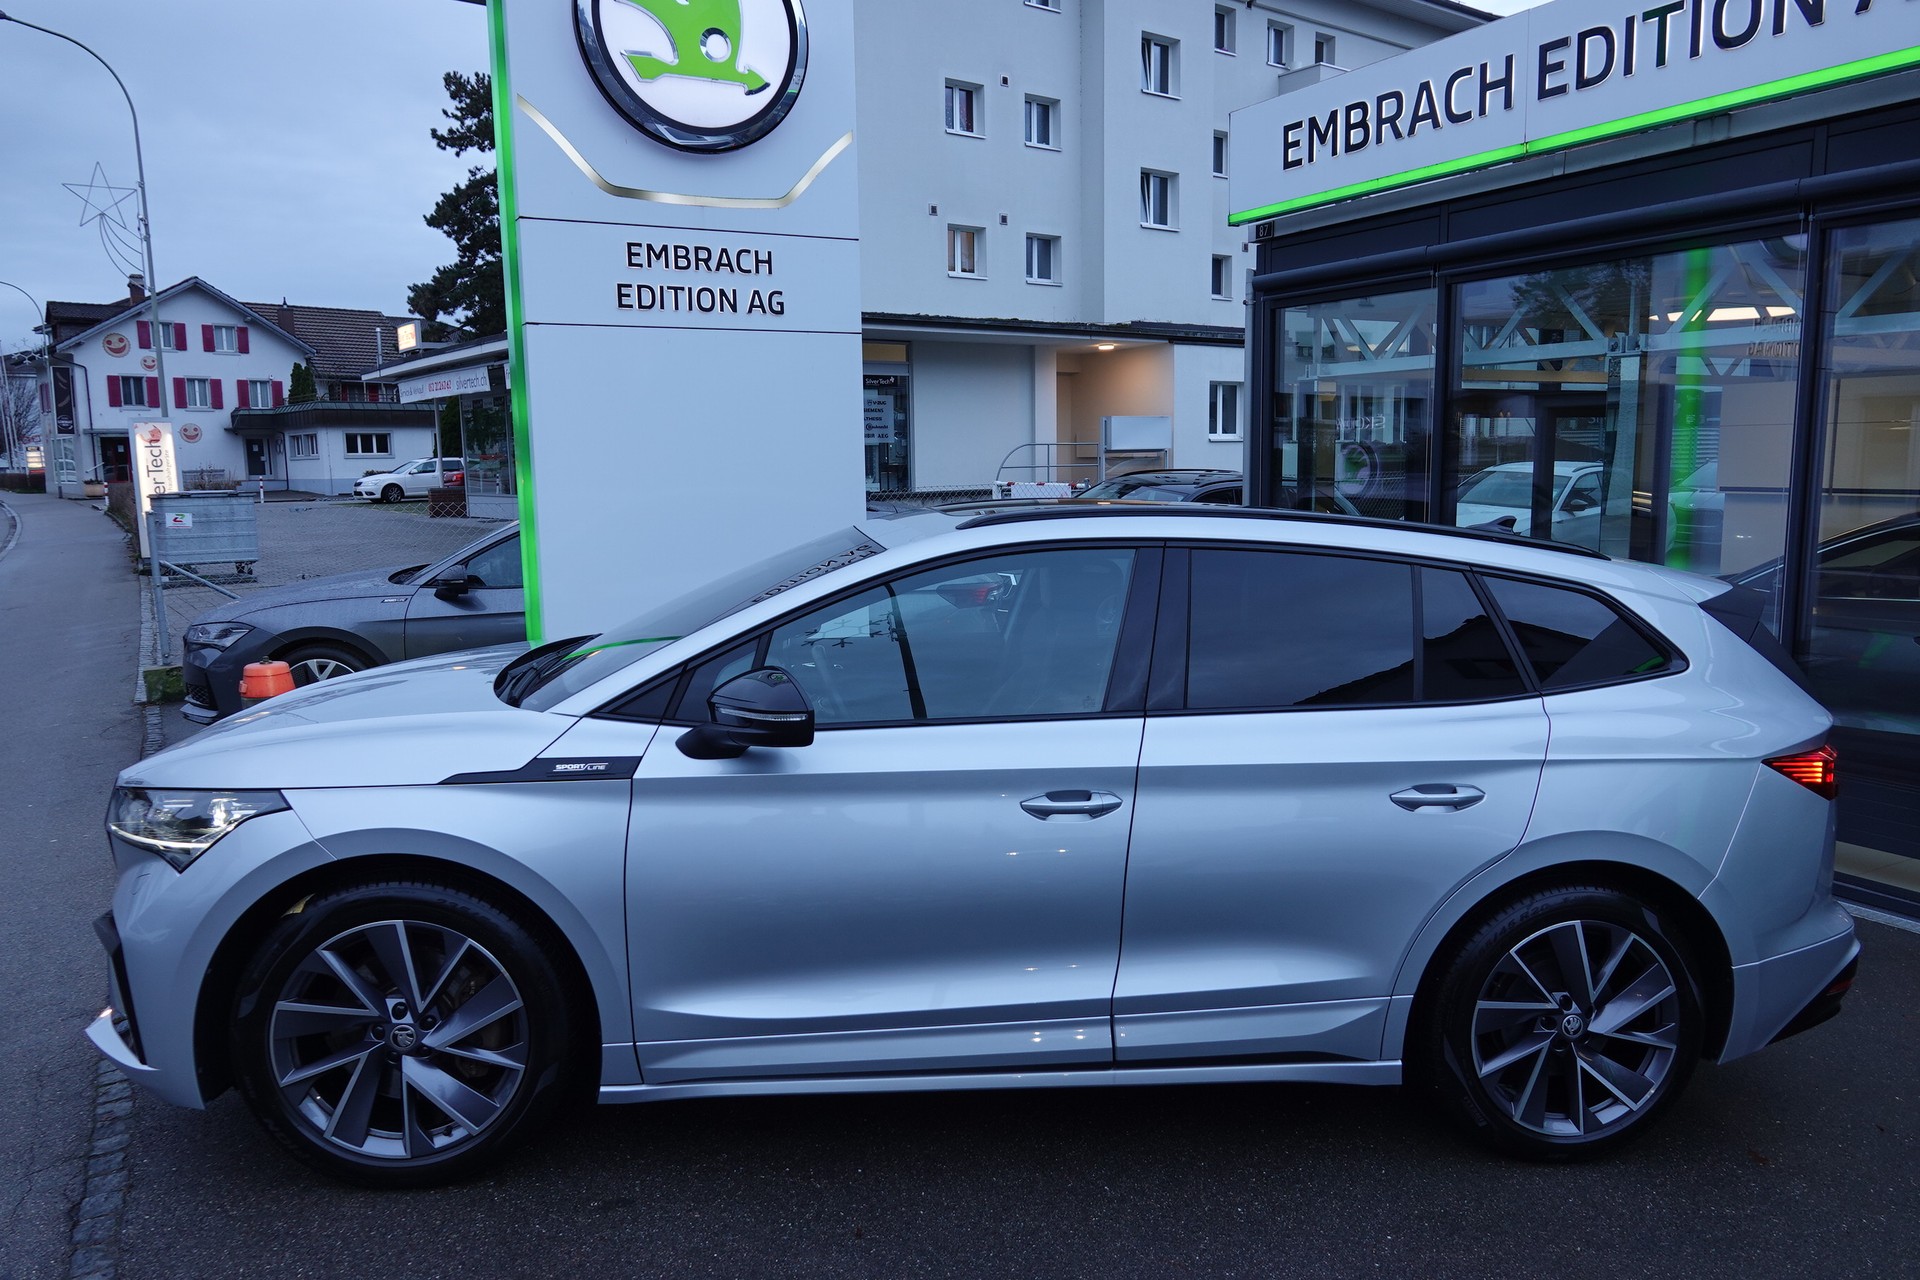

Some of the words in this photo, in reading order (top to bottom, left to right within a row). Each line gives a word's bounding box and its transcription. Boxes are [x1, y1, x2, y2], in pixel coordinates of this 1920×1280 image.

[1283, 53, 1514, 171] EMBRACH
[1260, 225, 1269, 237] 87
[626, 241, 773, 275] EMBRACH
[616, 283, 738, 313] EDITION
[747, 289, 785, 315] AG
